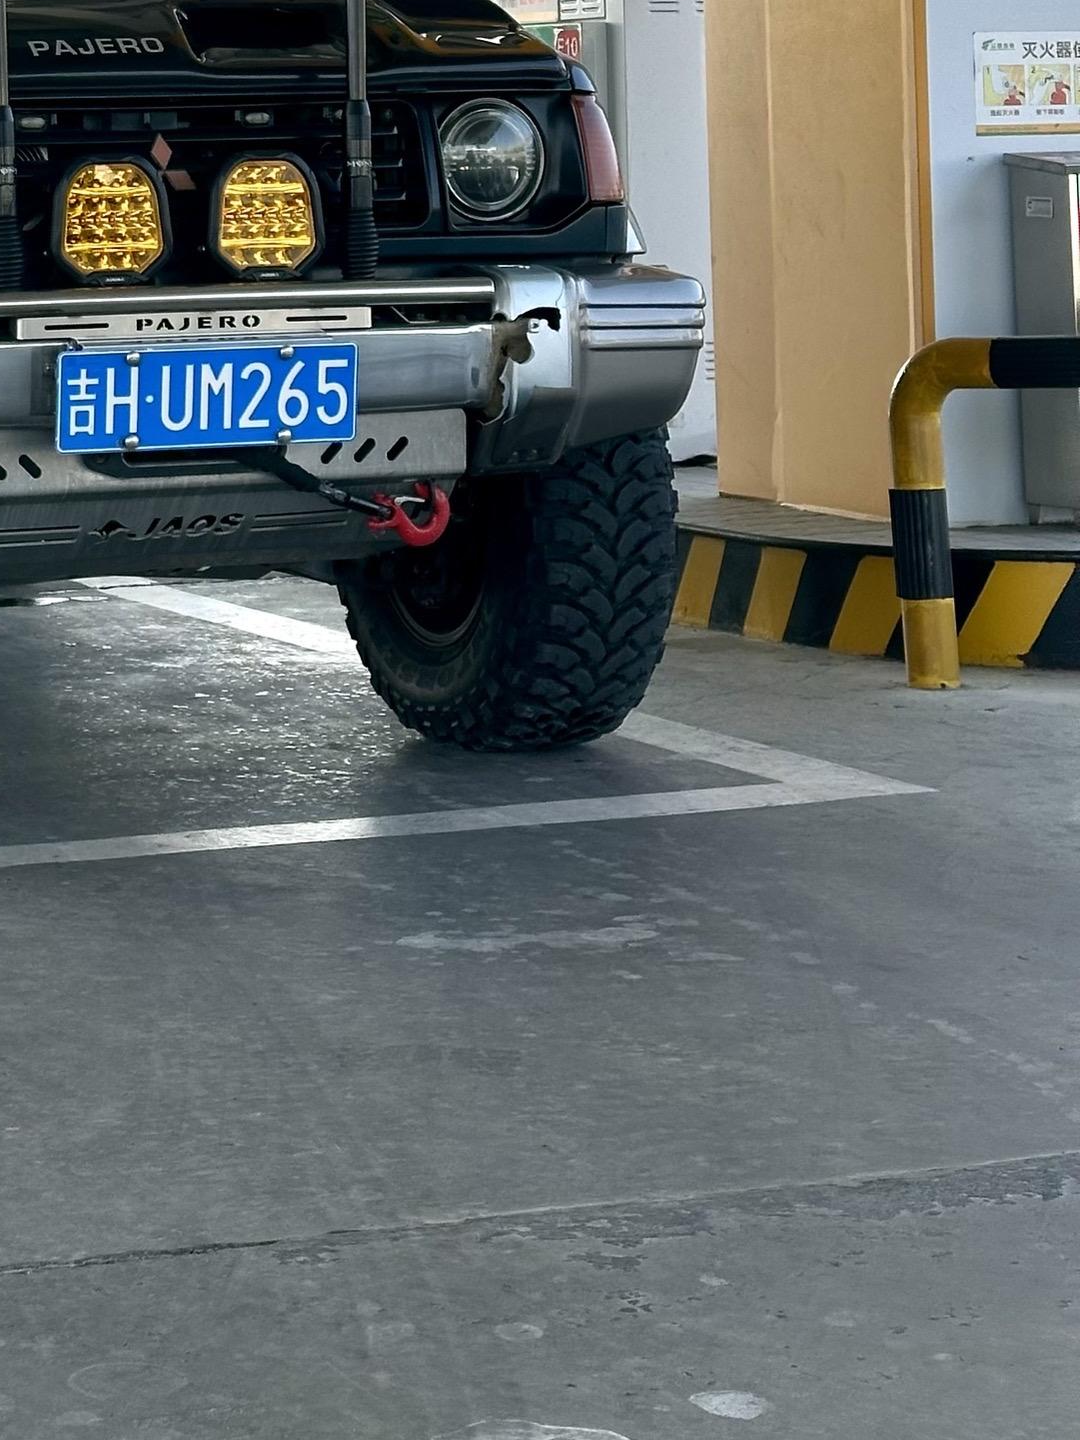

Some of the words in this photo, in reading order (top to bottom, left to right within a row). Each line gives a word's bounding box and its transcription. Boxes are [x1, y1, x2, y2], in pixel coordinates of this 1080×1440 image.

[26, 37, 165, 57] PAJERO
[136, 314, 262, 331] PAJERO
[126, 512, 246, 541] JAOS
